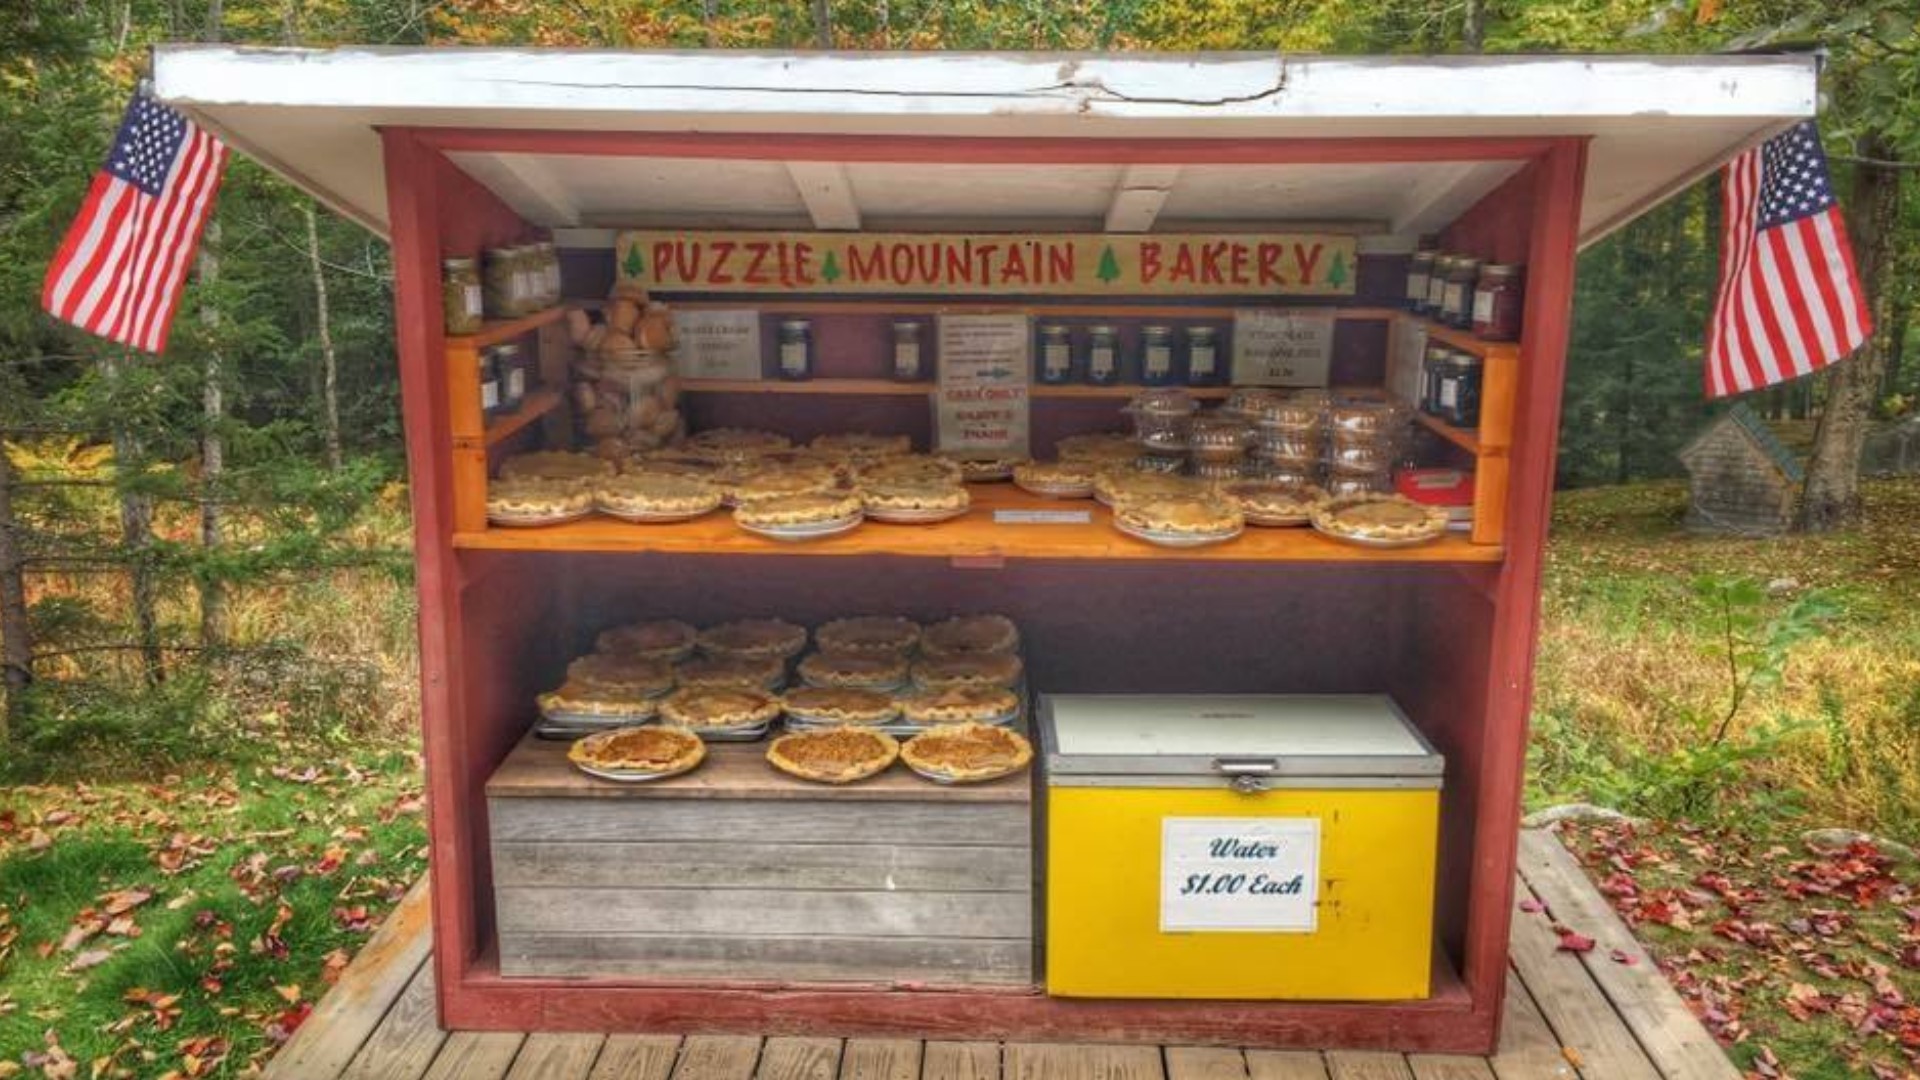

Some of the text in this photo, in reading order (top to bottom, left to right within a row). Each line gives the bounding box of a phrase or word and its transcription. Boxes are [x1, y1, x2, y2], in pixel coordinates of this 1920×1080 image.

[652, 240, 1323, 288] PUZZLE MOUNTAIN BAKERY
[1209, 838, 1279, 858] Water
[1180, 873, 1303, 895] $1.00 Each
